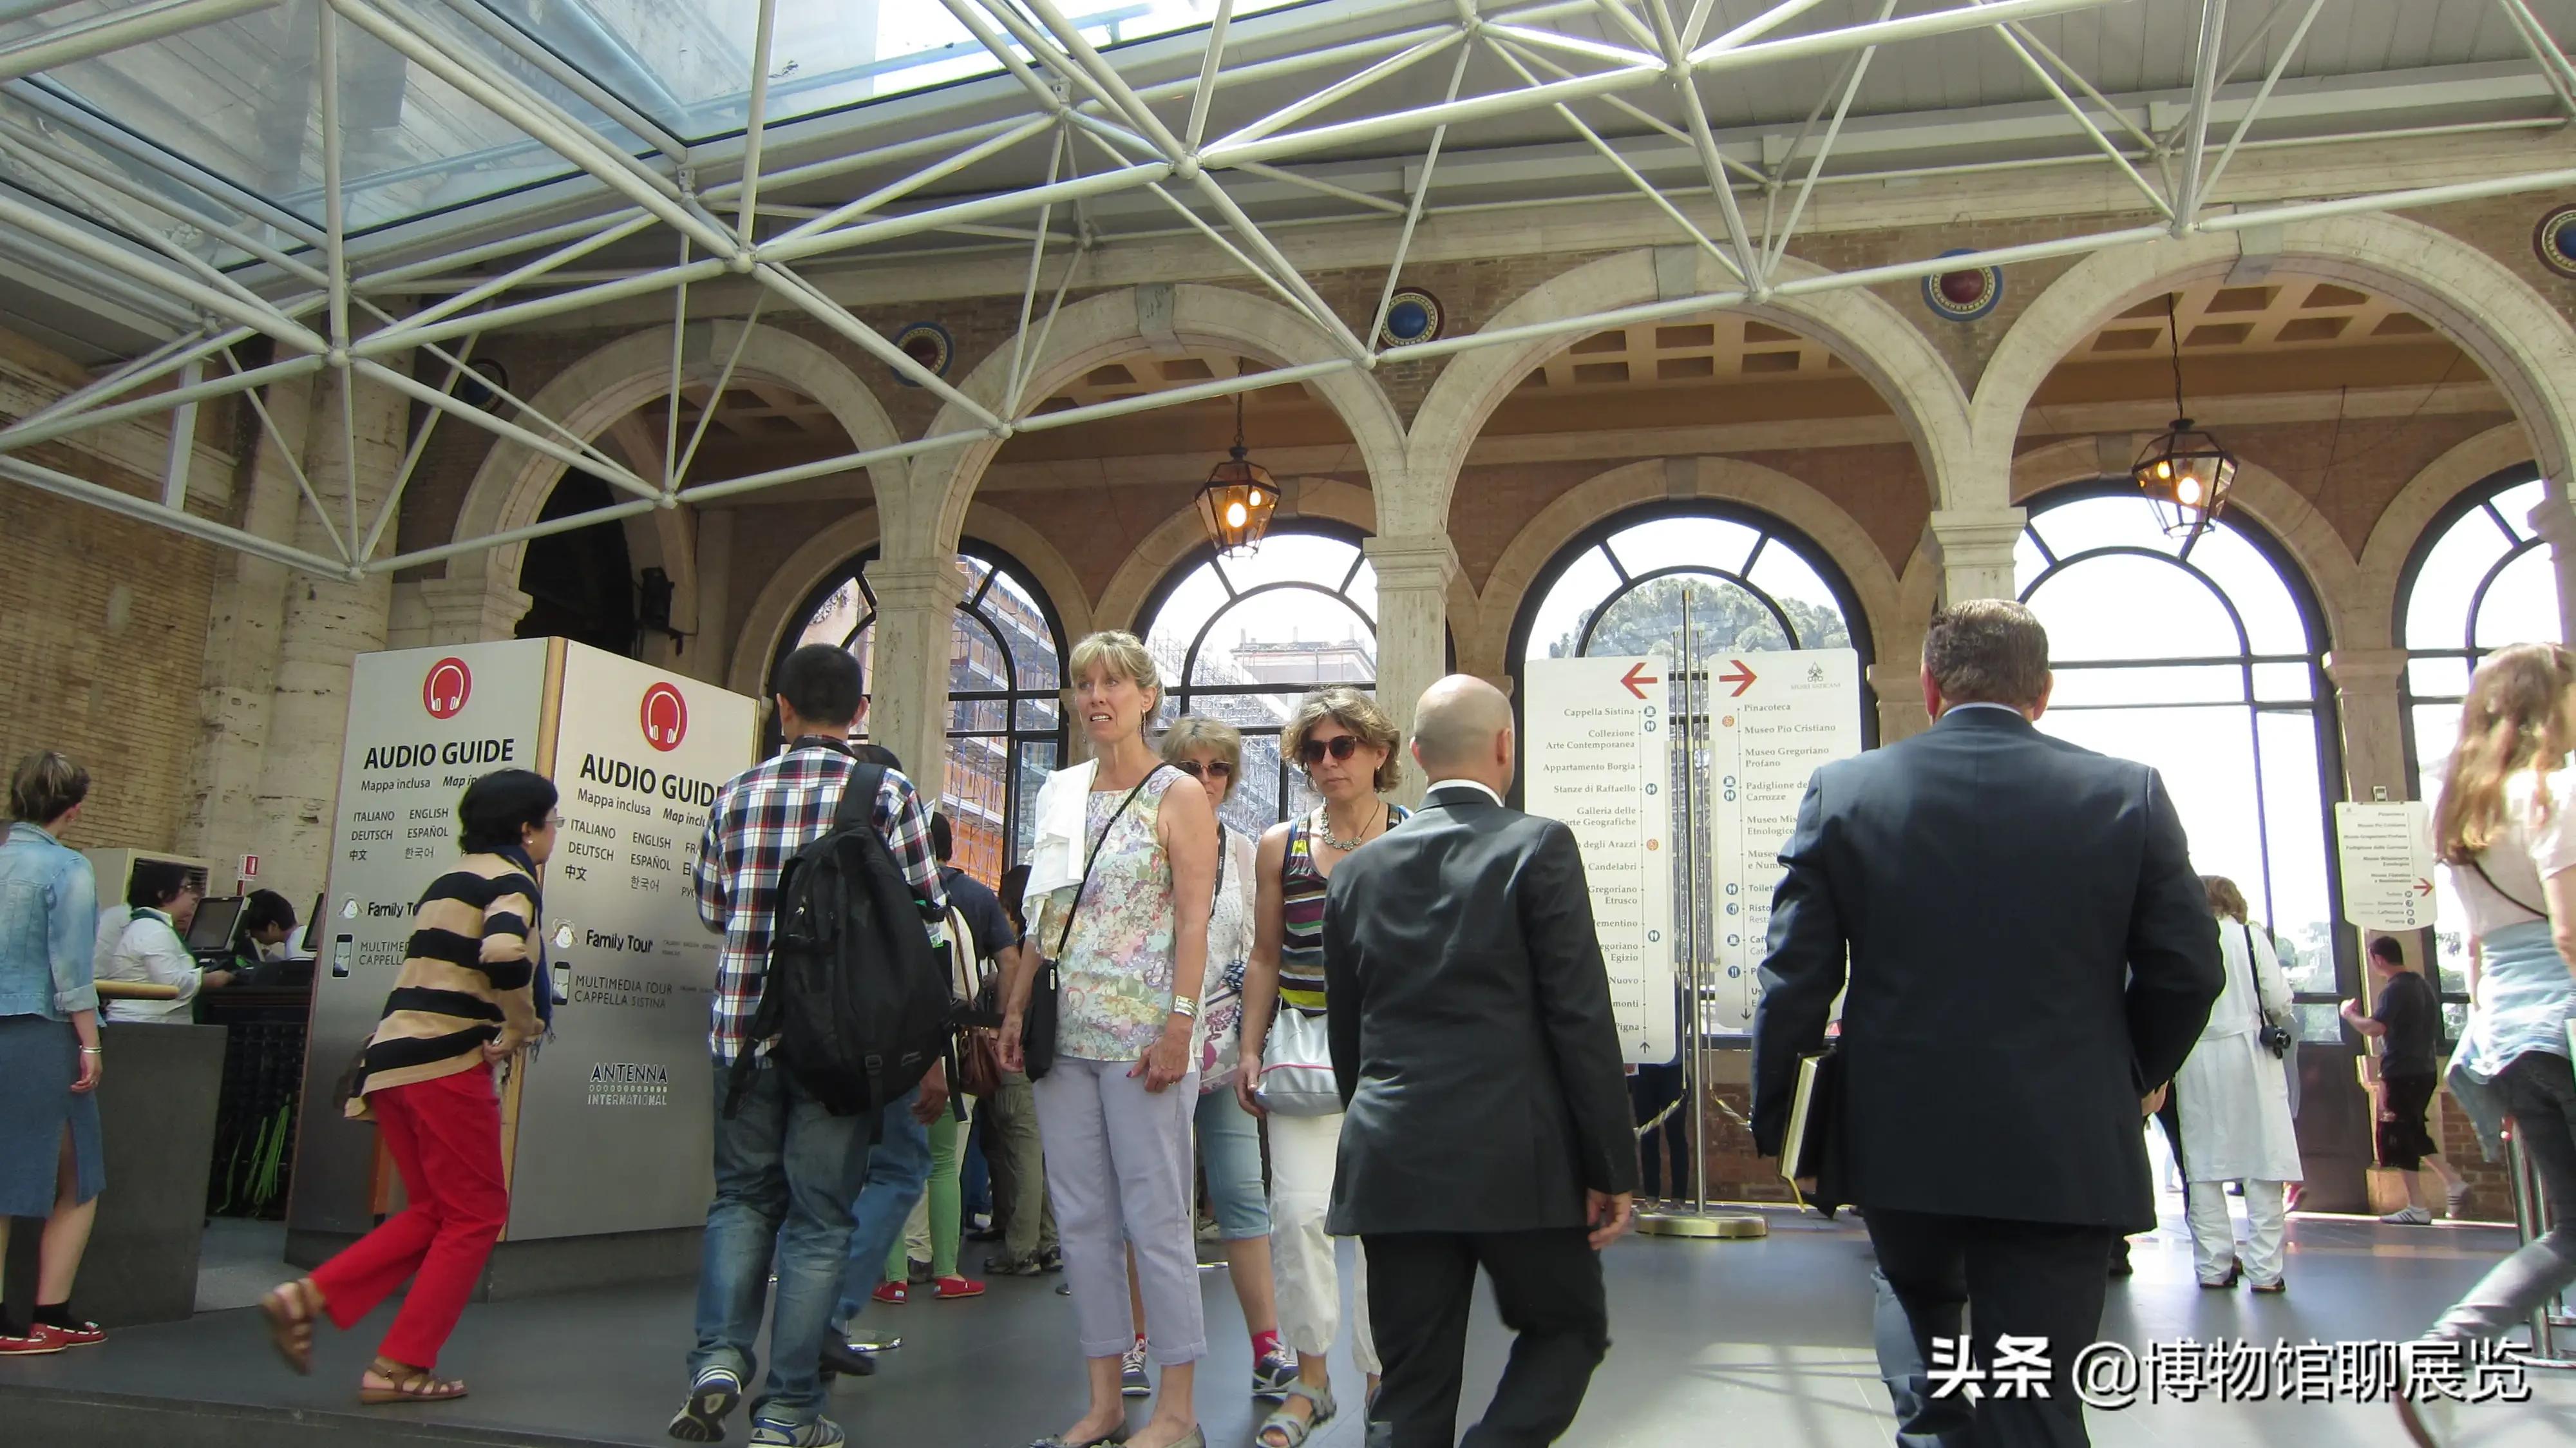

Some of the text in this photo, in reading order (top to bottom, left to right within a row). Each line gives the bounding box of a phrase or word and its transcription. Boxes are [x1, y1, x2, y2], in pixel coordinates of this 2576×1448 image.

[1564, 707, 1634, 718] Cappella Sistina
[1588, 729, 1635, 738] Collezione
[1745, 726, 1775, 734] Museo
[1794, 724, 1836, 732] Cristiano
[1567, 741, 1635, 750] Contemporanea
[364, 739, 515, 769] AUDIO GUIDE
[1777, 747, 1829, 757] Gregoriano
[1543, 763, 1636, 773] Appartamento Borgia
[1745, 759, 1781, 768] Profano
[580, 754, 656, 794] AUDIO
[361, 777, 430, 792] Mappa inclusa
[443, 776, 466, 788] Map
[1746, 781, 1794, 791] Padiglione
[1584, 785, 1593, 793] di
[1596, 784, 1636, 792] Raffaello
[578, 788, 651, 815] Mappa inclusa
[1746, 793, 1786, 801] Carrozze
[354, 810, 395, 822] ITALIANO
[410, 808, 448, 819] ENGLISH
[663, 808, 684, 824] Map
[1577, 806, 1636, 815] Galleria delle
[1583, 817, 1636, 828] Geografiche
[407, 825, 448, 838] ESPAÑOL
[571, 819, 616, 839] ITALIANO
[1747, 826, 1795, 836] Etnologico
[352, 830, 393, 841] DEUTSCH
[633, 832, 671, 848] ENGLISH
[1584, 840, 1605, 850] degli
[1609, 840, 1636, 848] Arazzi
[350, 849, 367, 861] 中文
[405, 847, 434, 859] 한국어
[569, 842, 614, 861] DEUTSCH
[631, 854, 670, 870] ESPAÑOL
[1588, 862, 1637, 871] Candelabri
[565, 864, 587, 882] 中文
[631, 875, 659, 893] 한국어
[1587, 885, 1637, 895] Gregoriano
[368, 902, 403, 918] Family
[361, 942, 409, 951] MULTIME
[586, 929, 623, 951] Family
[628, 935, 653, 953] Tour
[1600, 942, 1638, 952] egoriano
[359, 955, 403, 965] CAPPELL
[1611, 953, 1638, 963] Egizio
[576, 975, 642, 992] MULTIMEDIA
[645, 982, 672, 995] TOUR
[574, 990, 666, 1008] CAPPELLA SISTINA
[590, 1062, 668, 1084] ANTENNA
[587, 1094, 667, 1105] INTERNATIONAL
